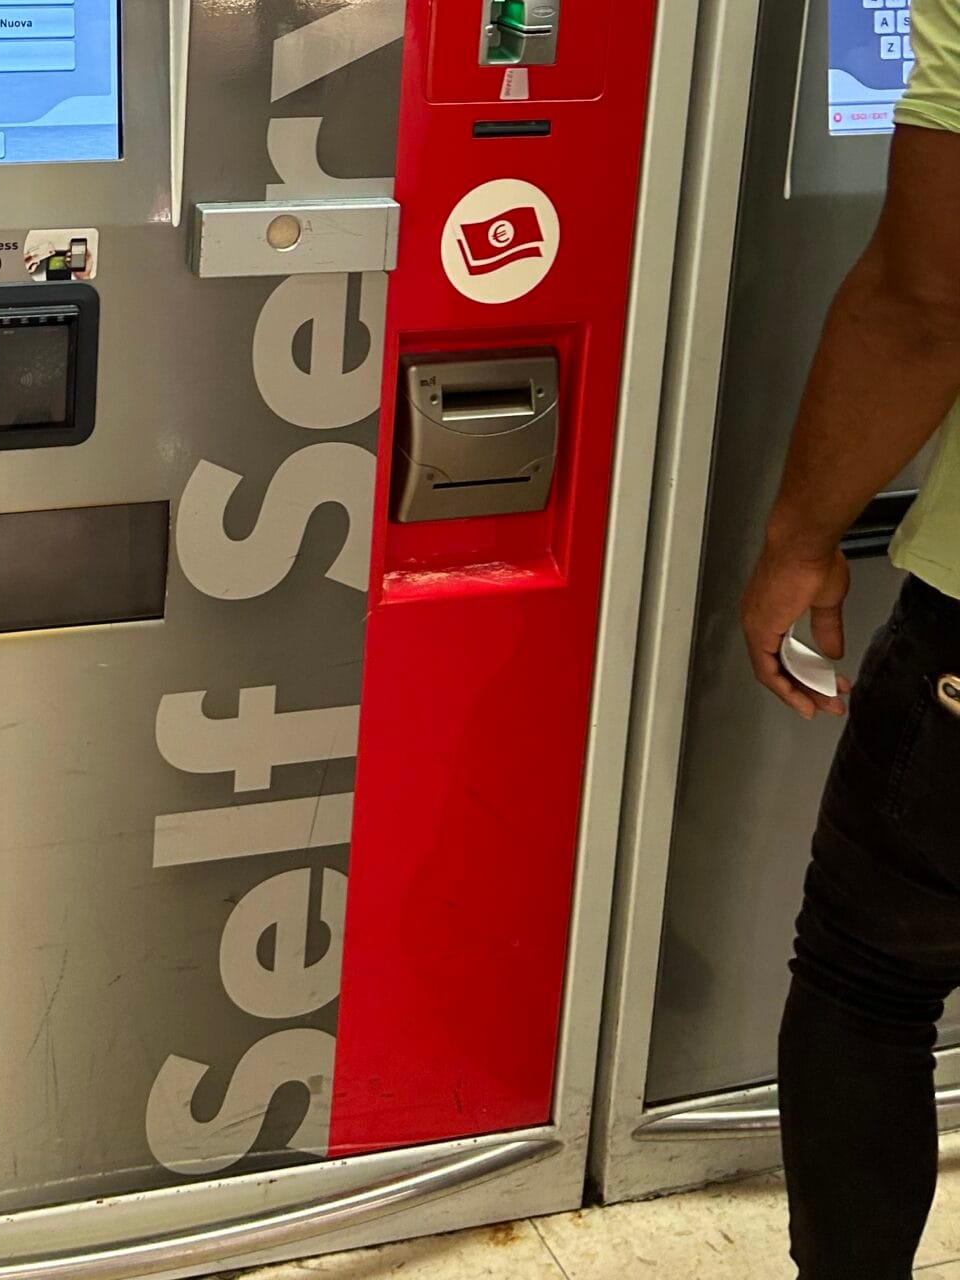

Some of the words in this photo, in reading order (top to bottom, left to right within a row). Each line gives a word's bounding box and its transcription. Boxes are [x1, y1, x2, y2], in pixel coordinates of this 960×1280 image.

[0, 18, 33, 28] Nuova
[880, 17, 889, 27] A
[887, 42, 894, 52] Z
[144, 682, 362, 1176] Self
